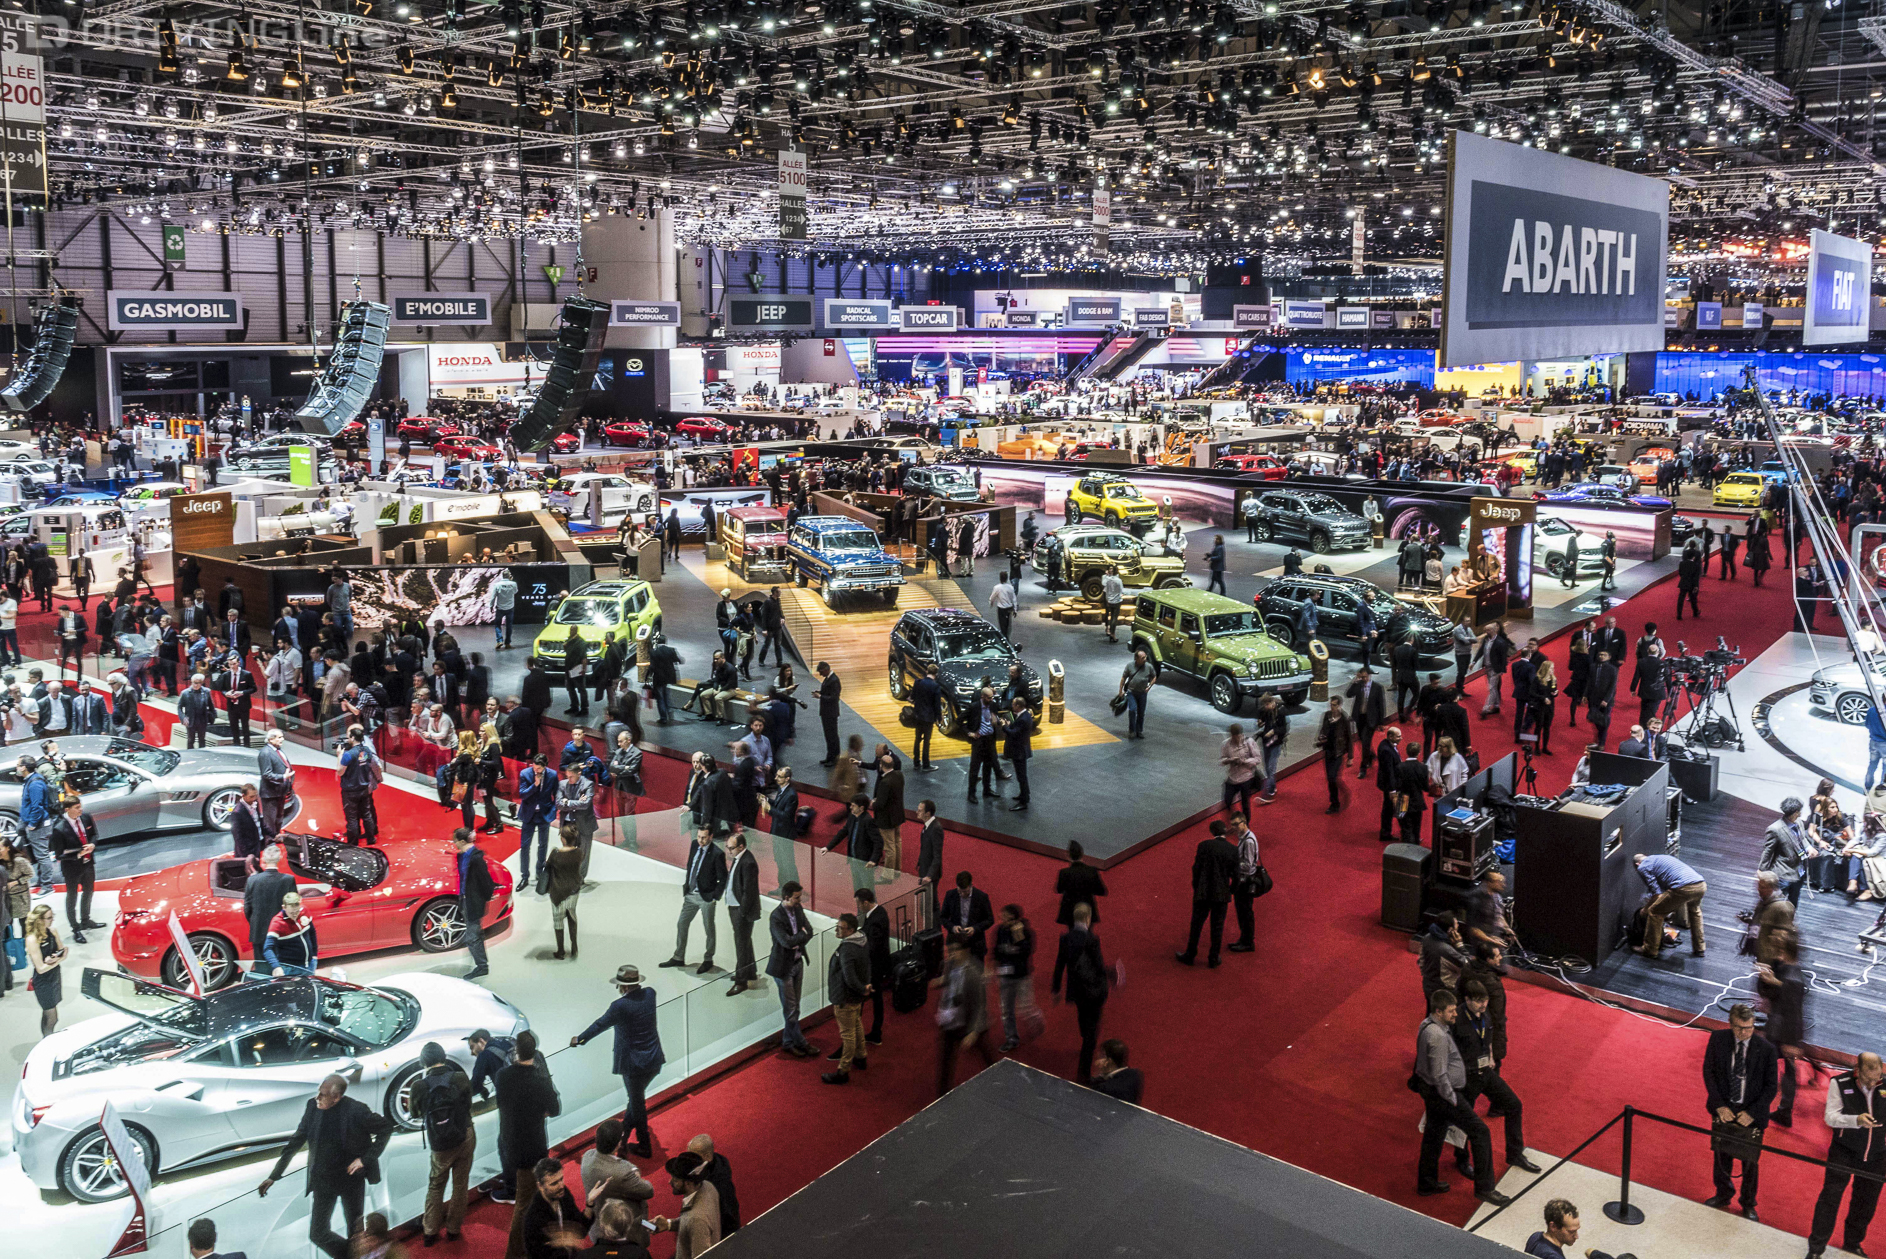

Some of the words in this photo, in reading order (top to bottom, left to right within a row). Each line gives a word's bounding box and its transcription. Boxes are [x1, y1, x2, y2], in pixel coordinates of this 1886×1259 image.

[3, 31, 19, 53] 5
[782, 160, 803, 169] ALLÉE
[780, 171, 806, 186] 5100
[780, 199, 806, 209] HALLES
[1094, 206, 1109, 216] 5000
[1502, 218, 1638, 296] ABARTH
[1832, 270, 1855, 310] FIAT
[124, 303, 230, 318] GASMOBIL
[755, 305, 787, 323] JEEP
[910, 313, 948, 324] TOPCAR
[1239, 313, 1247, 321] SIN
[1249, 313, 1260, 321] CARS
[1342, 313, 1365, 322] HAMANN
[437, 357, 493, 366] HONDA
[1623, 421, 1664, 430] YOKOHAMA
[183, 499, 223, 514] Jeep
[1480, 503, 1521, 521] Jeep
[532, 583, 547, 594] 75
